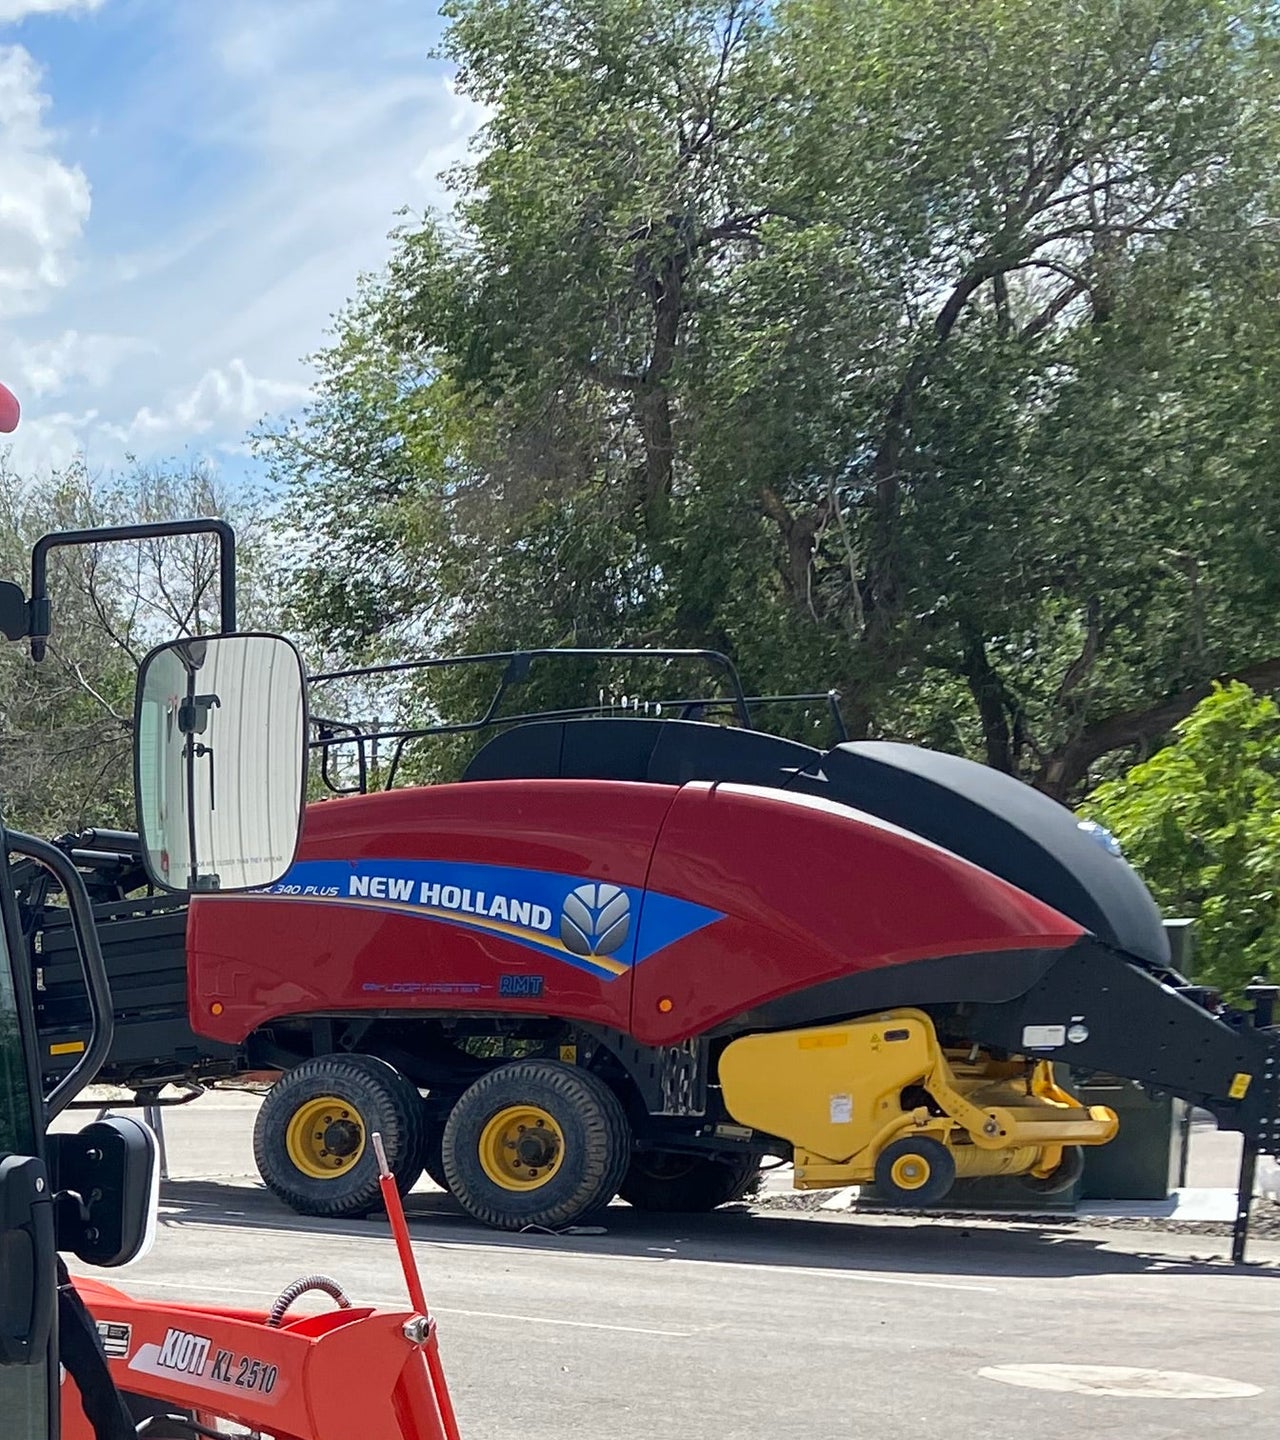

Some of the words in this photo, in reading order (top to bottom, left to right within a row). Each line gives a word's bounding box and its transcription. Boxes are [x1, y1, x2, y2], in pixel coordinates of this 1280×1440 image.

[303, 885, 340, 896] PLUS
[348, 875, 414, 901] NEW
[419, 882, 552, 931] HOLLAND
[498, 975, 544, 994] RMT
[157, 1326, 212, 1376] KIOTI
[211, 1350, 233, 1382] KL
[235, 1357, 279, 1394] 2510
